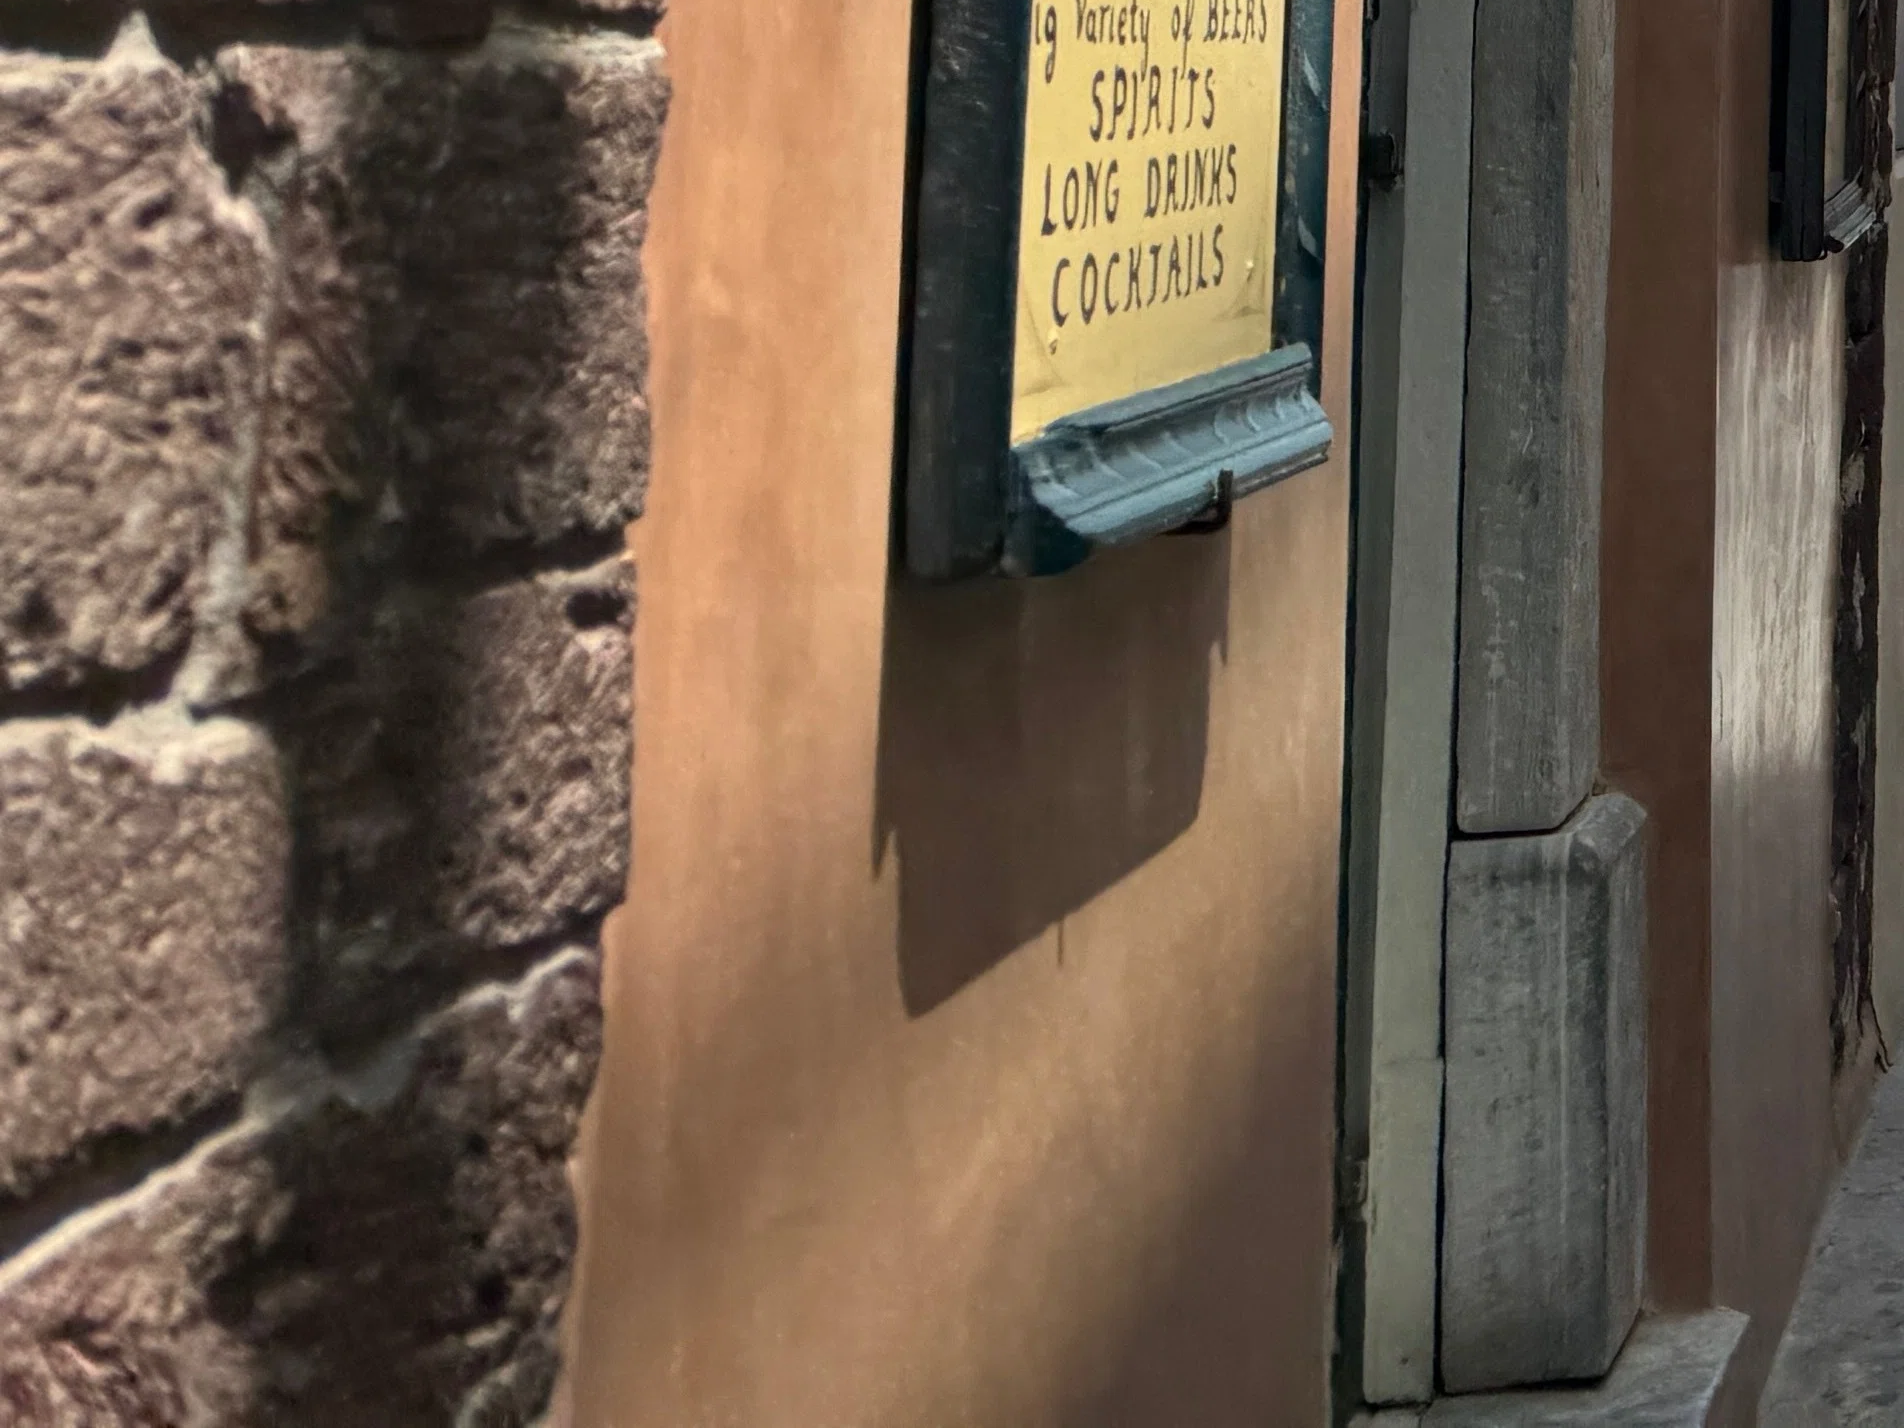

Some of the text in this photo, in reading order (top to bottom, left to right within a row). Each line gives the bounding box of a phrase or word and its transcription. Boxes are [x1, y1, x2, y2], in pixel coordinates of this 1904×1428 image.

[1089, 66, 1215, 142] SPIRITS
[1041, 144, 1237, 236] LONG DRINKS
[1051, 224, 1225, 327] COCKTAILS
